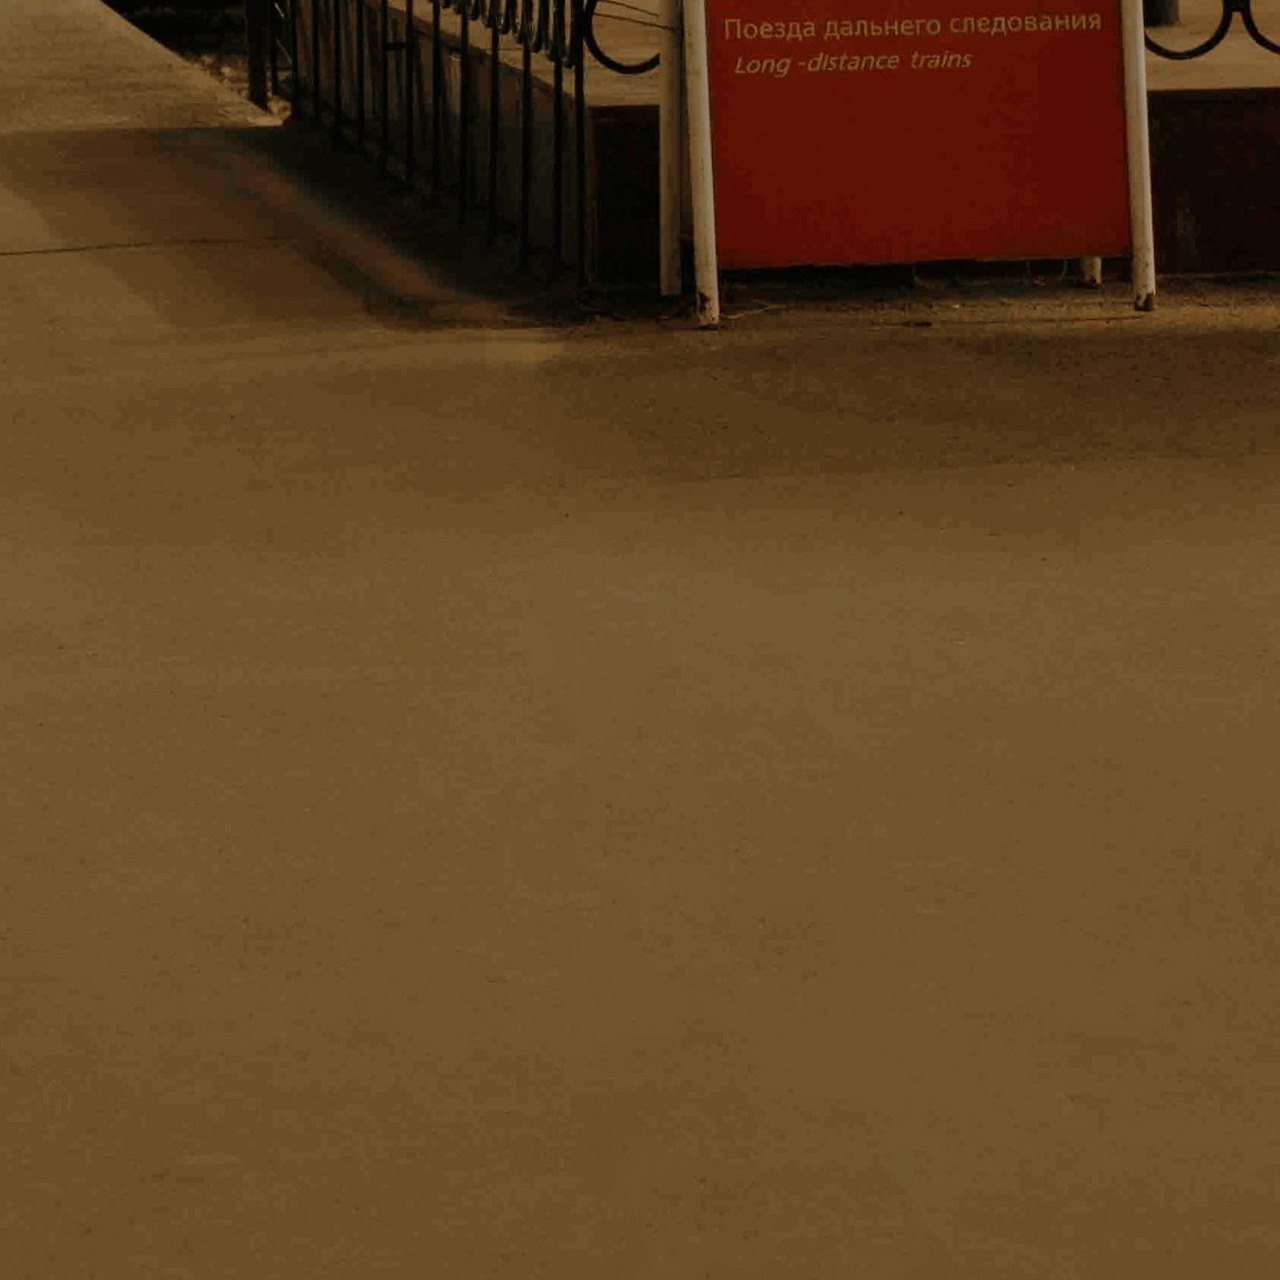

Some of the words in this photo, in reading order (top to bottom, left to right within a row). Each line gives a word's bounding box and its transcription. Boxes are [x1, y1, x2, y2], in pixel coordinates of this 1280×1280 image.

[724, 18, 817, 42] Поезда
[824, 17, 942, 41] дальнего
[950, 13, 1102, 37] следования
[910, 50, 973, 69] trains
